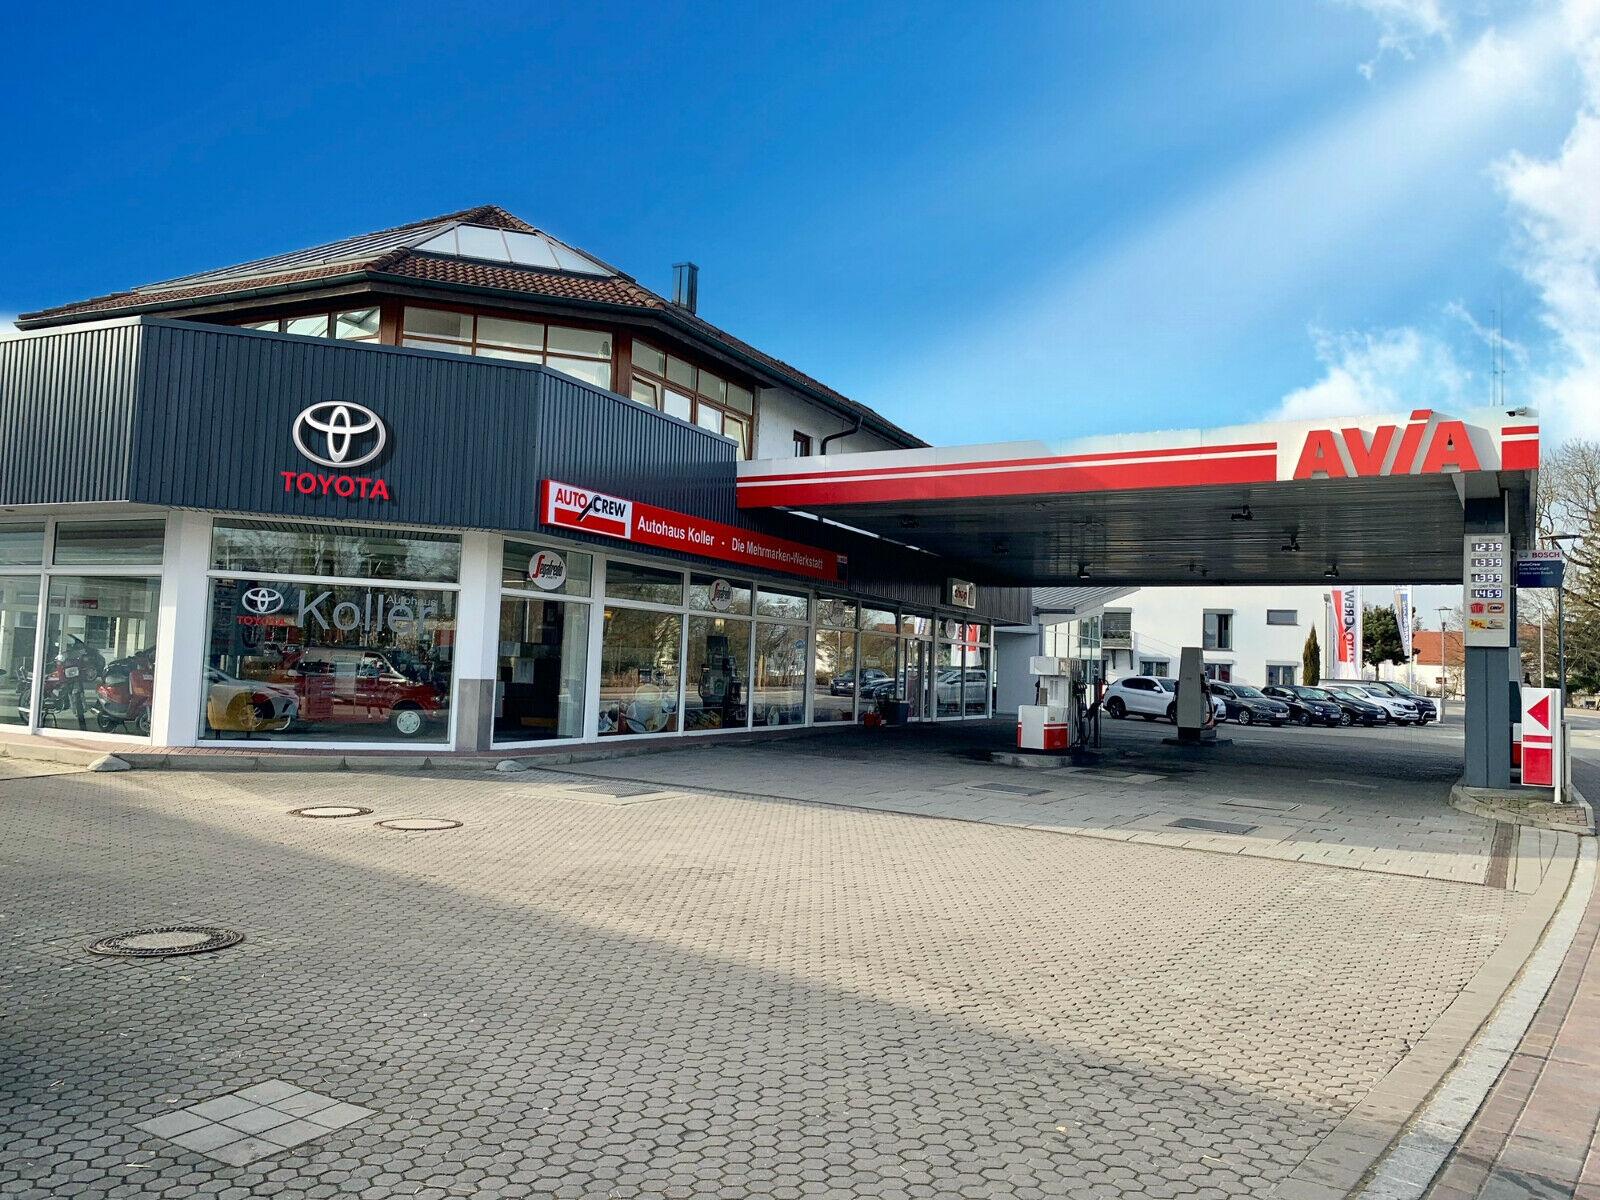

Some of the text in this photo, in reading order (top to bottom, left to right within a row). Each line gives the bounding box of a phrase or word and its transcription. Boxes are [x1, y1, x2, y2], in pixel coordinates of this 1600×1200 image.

[281, 471, 390, 500] TOYOTA
[637, 515, 686, 540] Autohaus
[687, 527, 715, 546] Koller
[731, 537, 746, 553] Die
[746, 540, 824, 569] Mehrmarken-Werkstatt
[1475, 543, 1502, 551] 1.239
[1531, 551, 1560, 559] BOSCH
[1475, 558, 1502, 567] 1.339
[1475, 574, 1502, 582] 1.399
[1475, 589, 1502, 597] 1.469
[386, 595, 439, 607] Autohaus
[298, 590, 433, 635] Koller
[236, 615, 287, 626] TOYOTA
